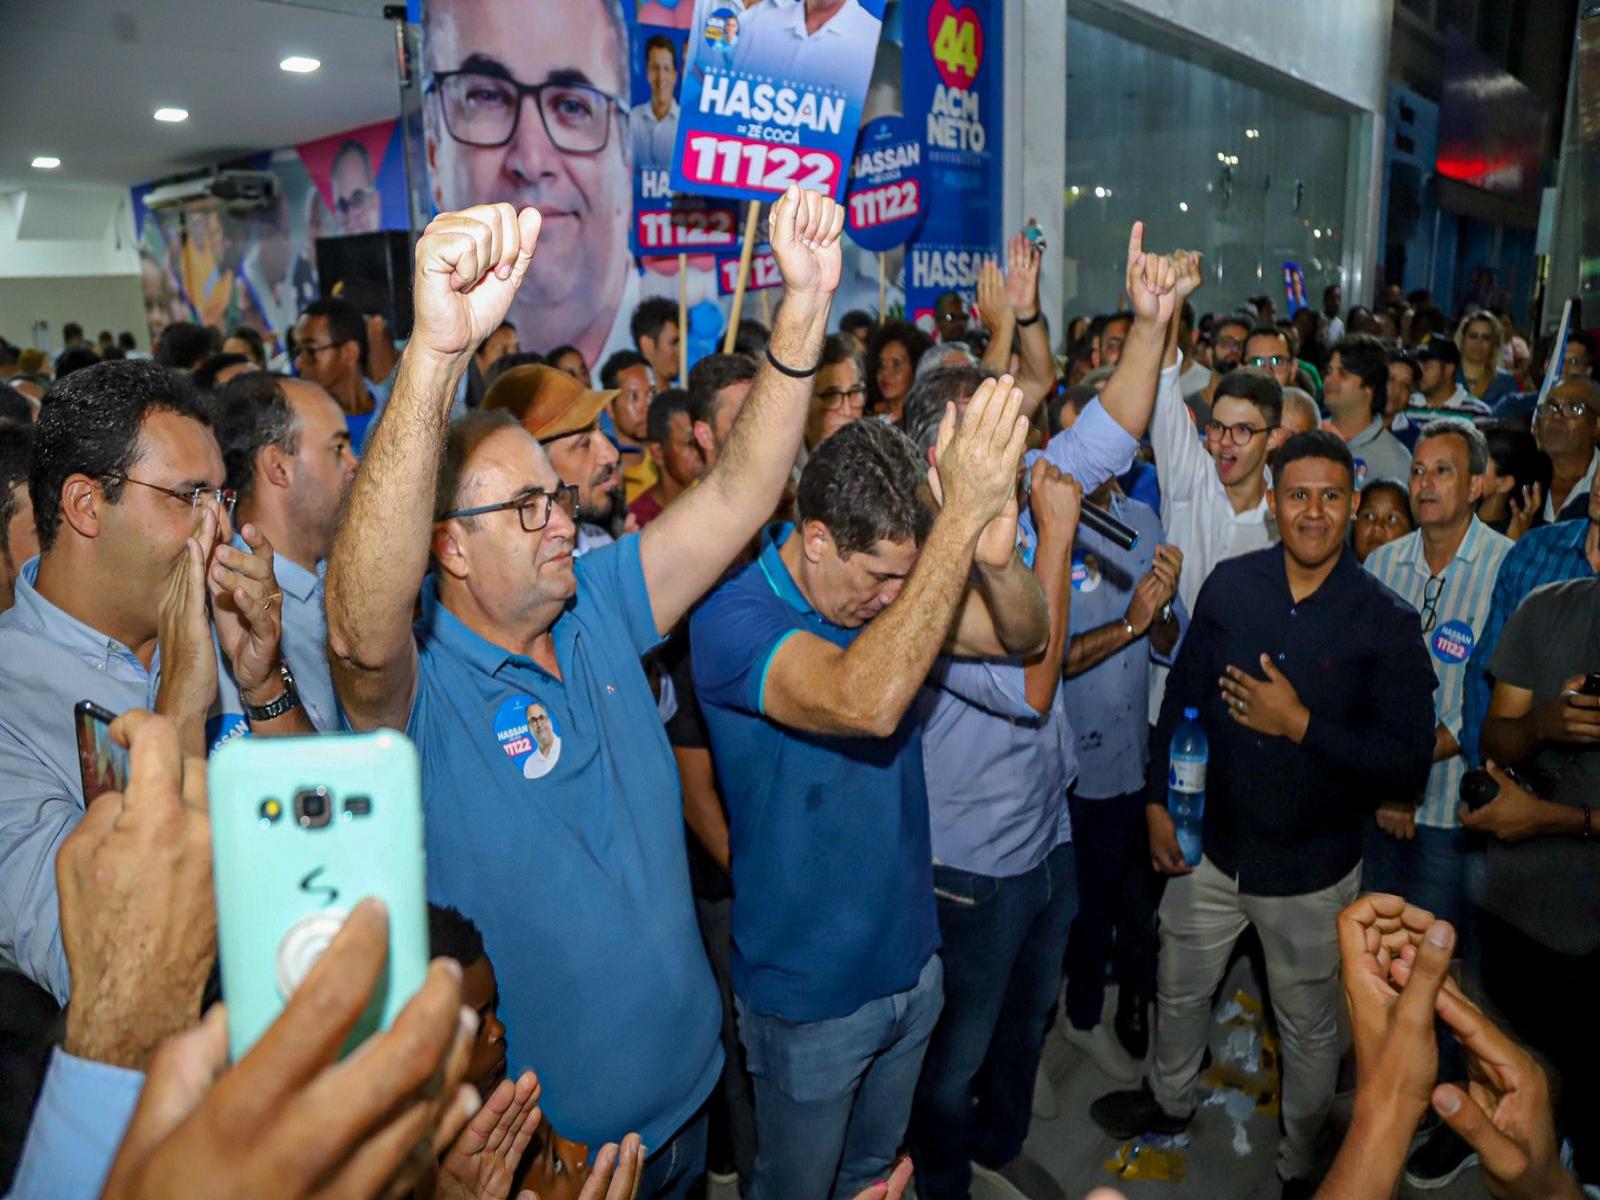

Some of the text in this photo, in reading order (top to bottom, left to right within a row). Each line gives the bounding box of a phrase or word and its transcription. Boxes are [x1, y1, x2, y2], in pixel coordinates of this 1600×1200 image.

[934, 15, 978, 78] 44
[699, 74, 846, 135] HASSAN
[932, 83, 979, 121] ACM
[927, 113, 986, 153] NETO
[690, 136, 835, 194] 11122
[850, 180, 918, 228] 11122
[640, 211, 731, 246] 11122
